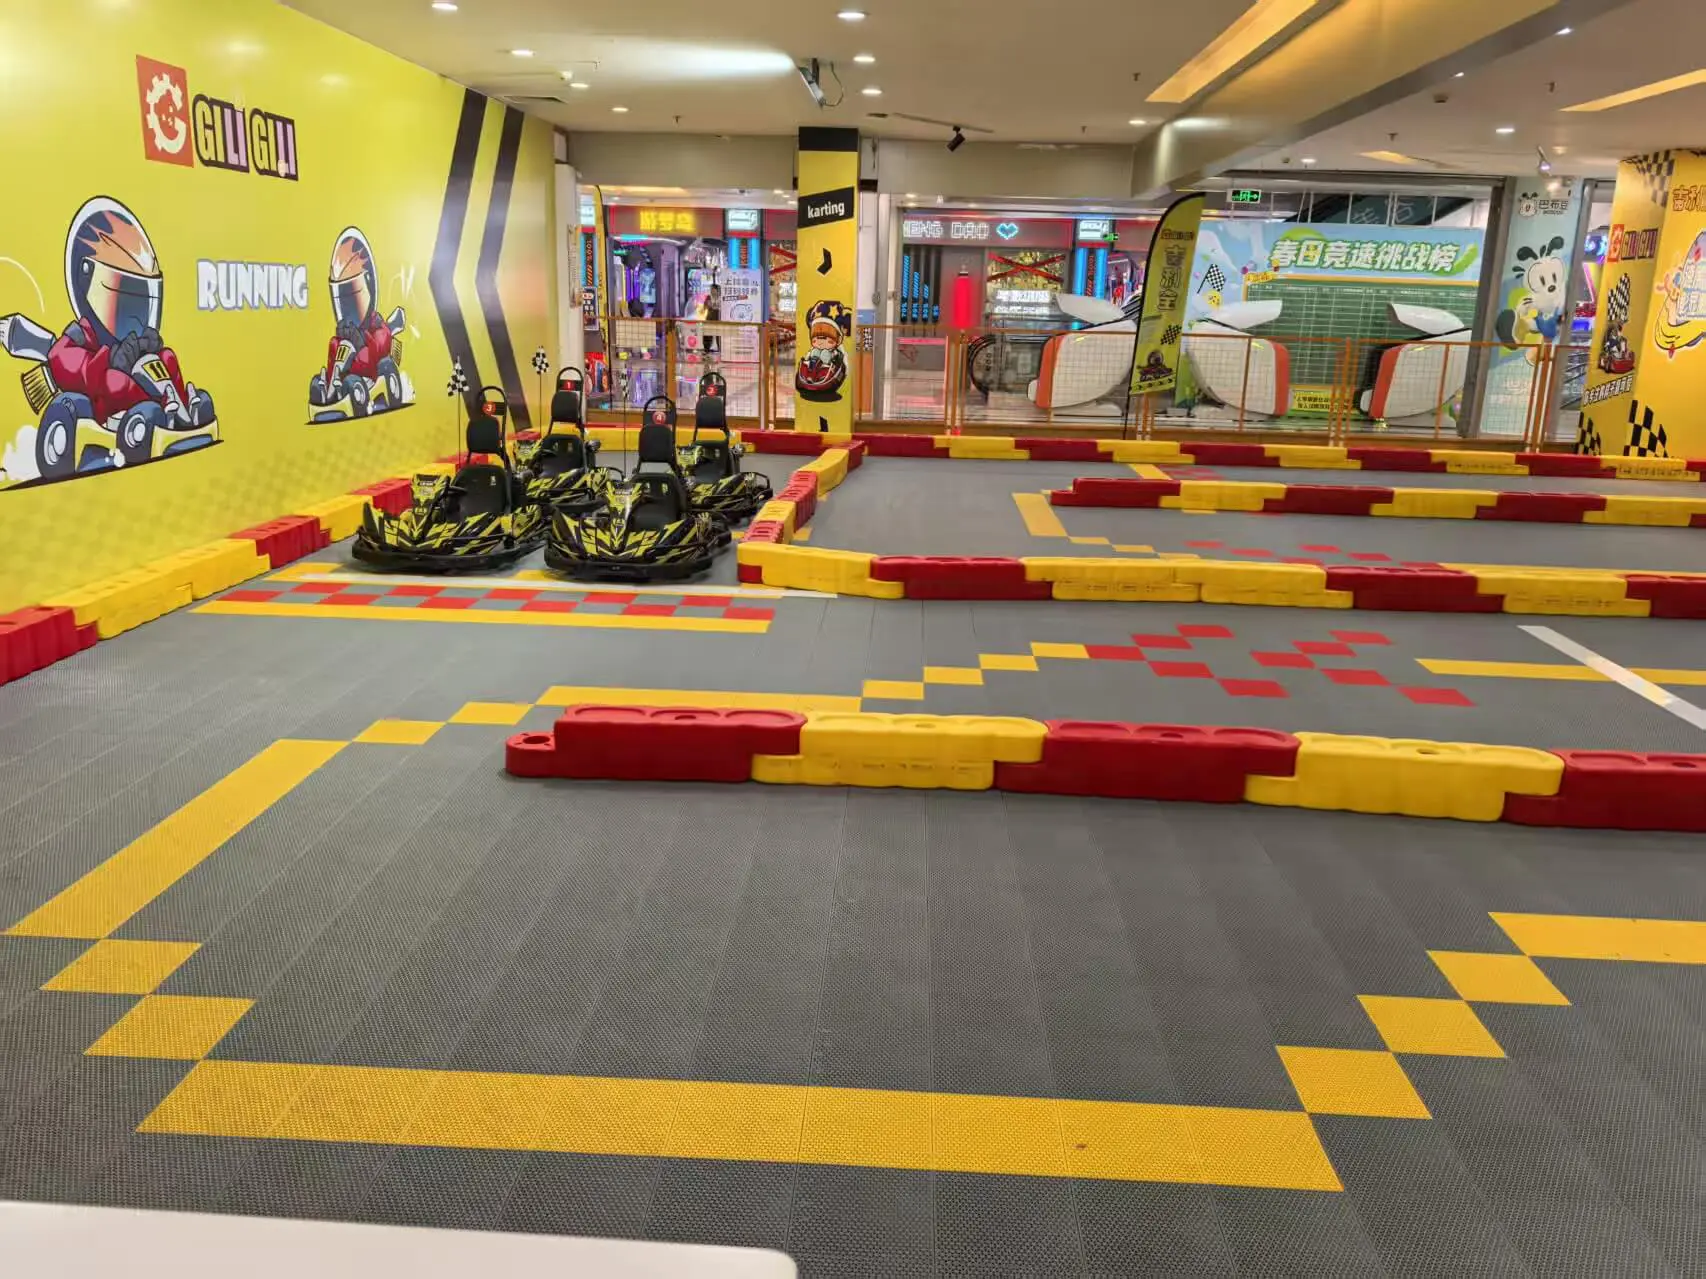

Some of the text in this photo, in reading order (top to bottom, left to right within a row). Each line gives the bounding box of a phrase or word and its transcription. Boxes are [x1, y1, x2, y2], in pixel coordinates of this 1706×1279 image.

[193, 95, 298, 181] GILI GILI
[807, 201, 845, 219] karting
[1539, 199, 1569, 210] 巴布豆
[1270, 239, 1460, 272] 春日竞速挑战榜
[197, 259, 309, 311] RUNNING
